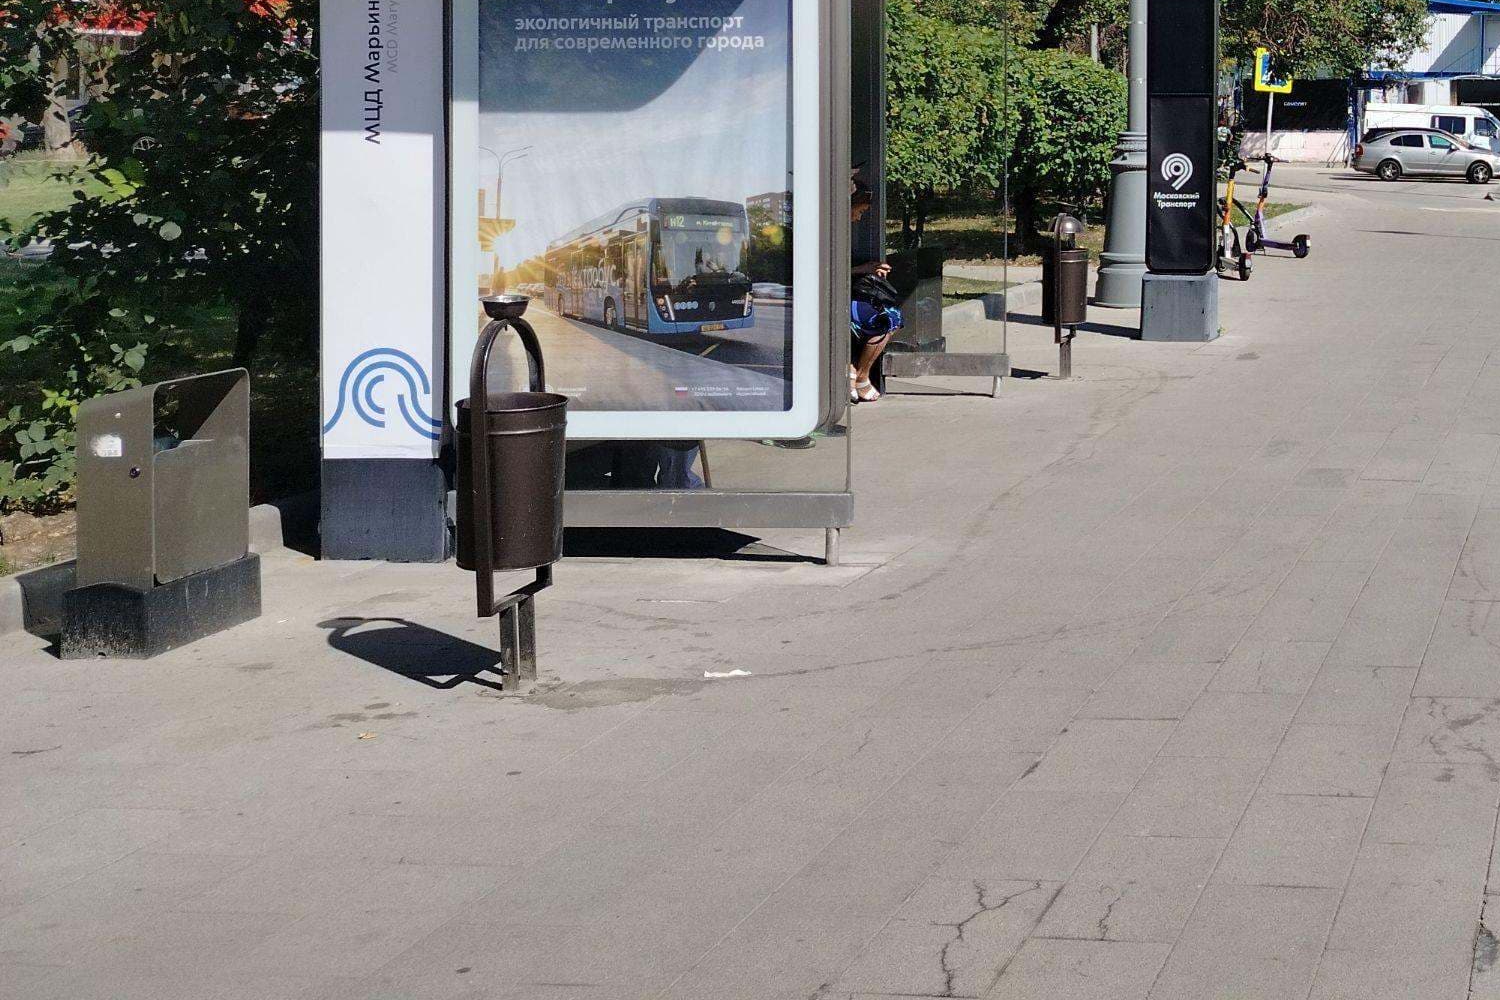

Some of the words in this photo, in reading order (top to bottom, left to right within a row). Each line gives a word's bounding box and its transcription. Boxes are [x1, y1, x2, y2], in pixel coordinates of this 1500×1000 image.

[514, 13, 639, 31] экологичный
[643, 15, 744, 32] транспорт
[514, 36, 549, 51] для
[553, 35, 693, 53] современного
[698, 33, 765, 52] города
[386, 40, 398, 74] MCD
[364, 89, 383, 144] МЦД
[1153, 191, 1200, 200] Московский
[1156, 199, 1197, 210] Транспорт
